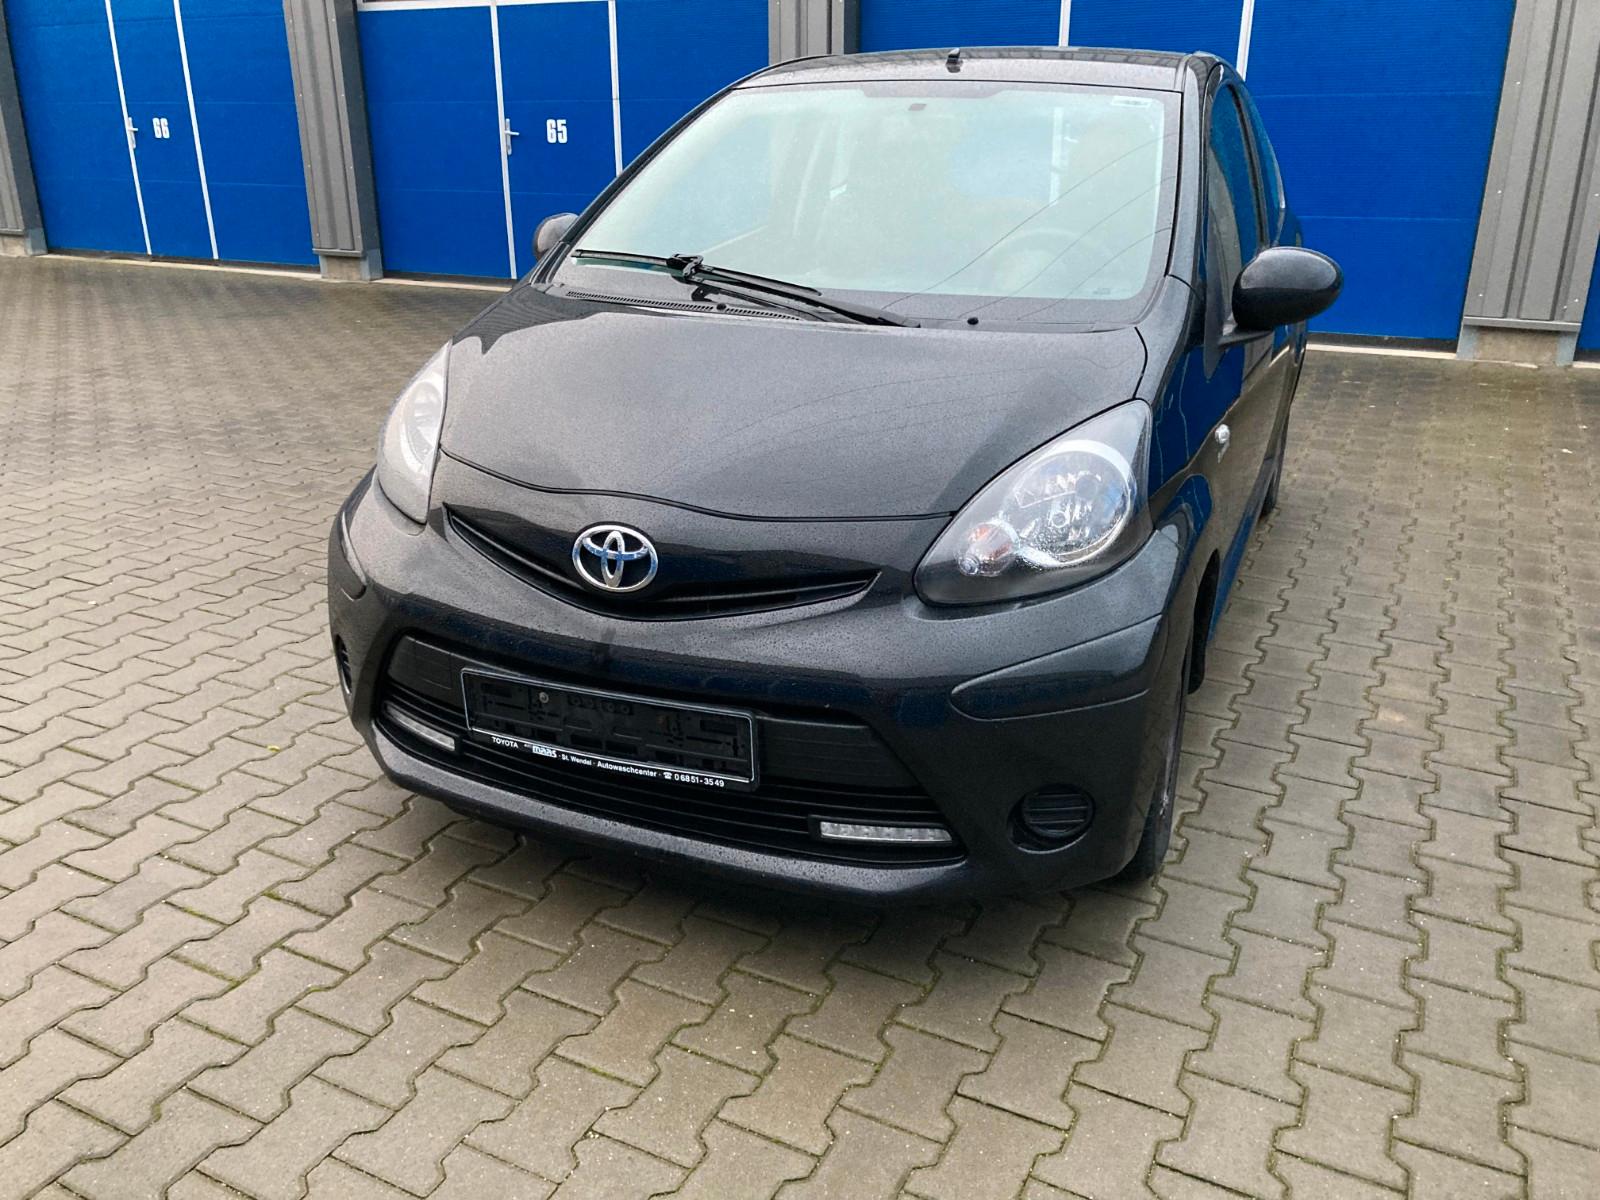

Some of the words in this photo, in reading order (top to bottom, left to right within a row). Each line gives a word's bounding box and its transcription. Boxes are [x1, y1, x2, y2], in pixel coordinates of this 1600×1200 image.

[152, 117, 170, 139] 66
[546, 119, 568, 144] 65
[491, 736, 519, 749] TOYOTA
[570, 756, 592, 766] Wendel
[597, 760, 657, 778] Autowaschcenter
